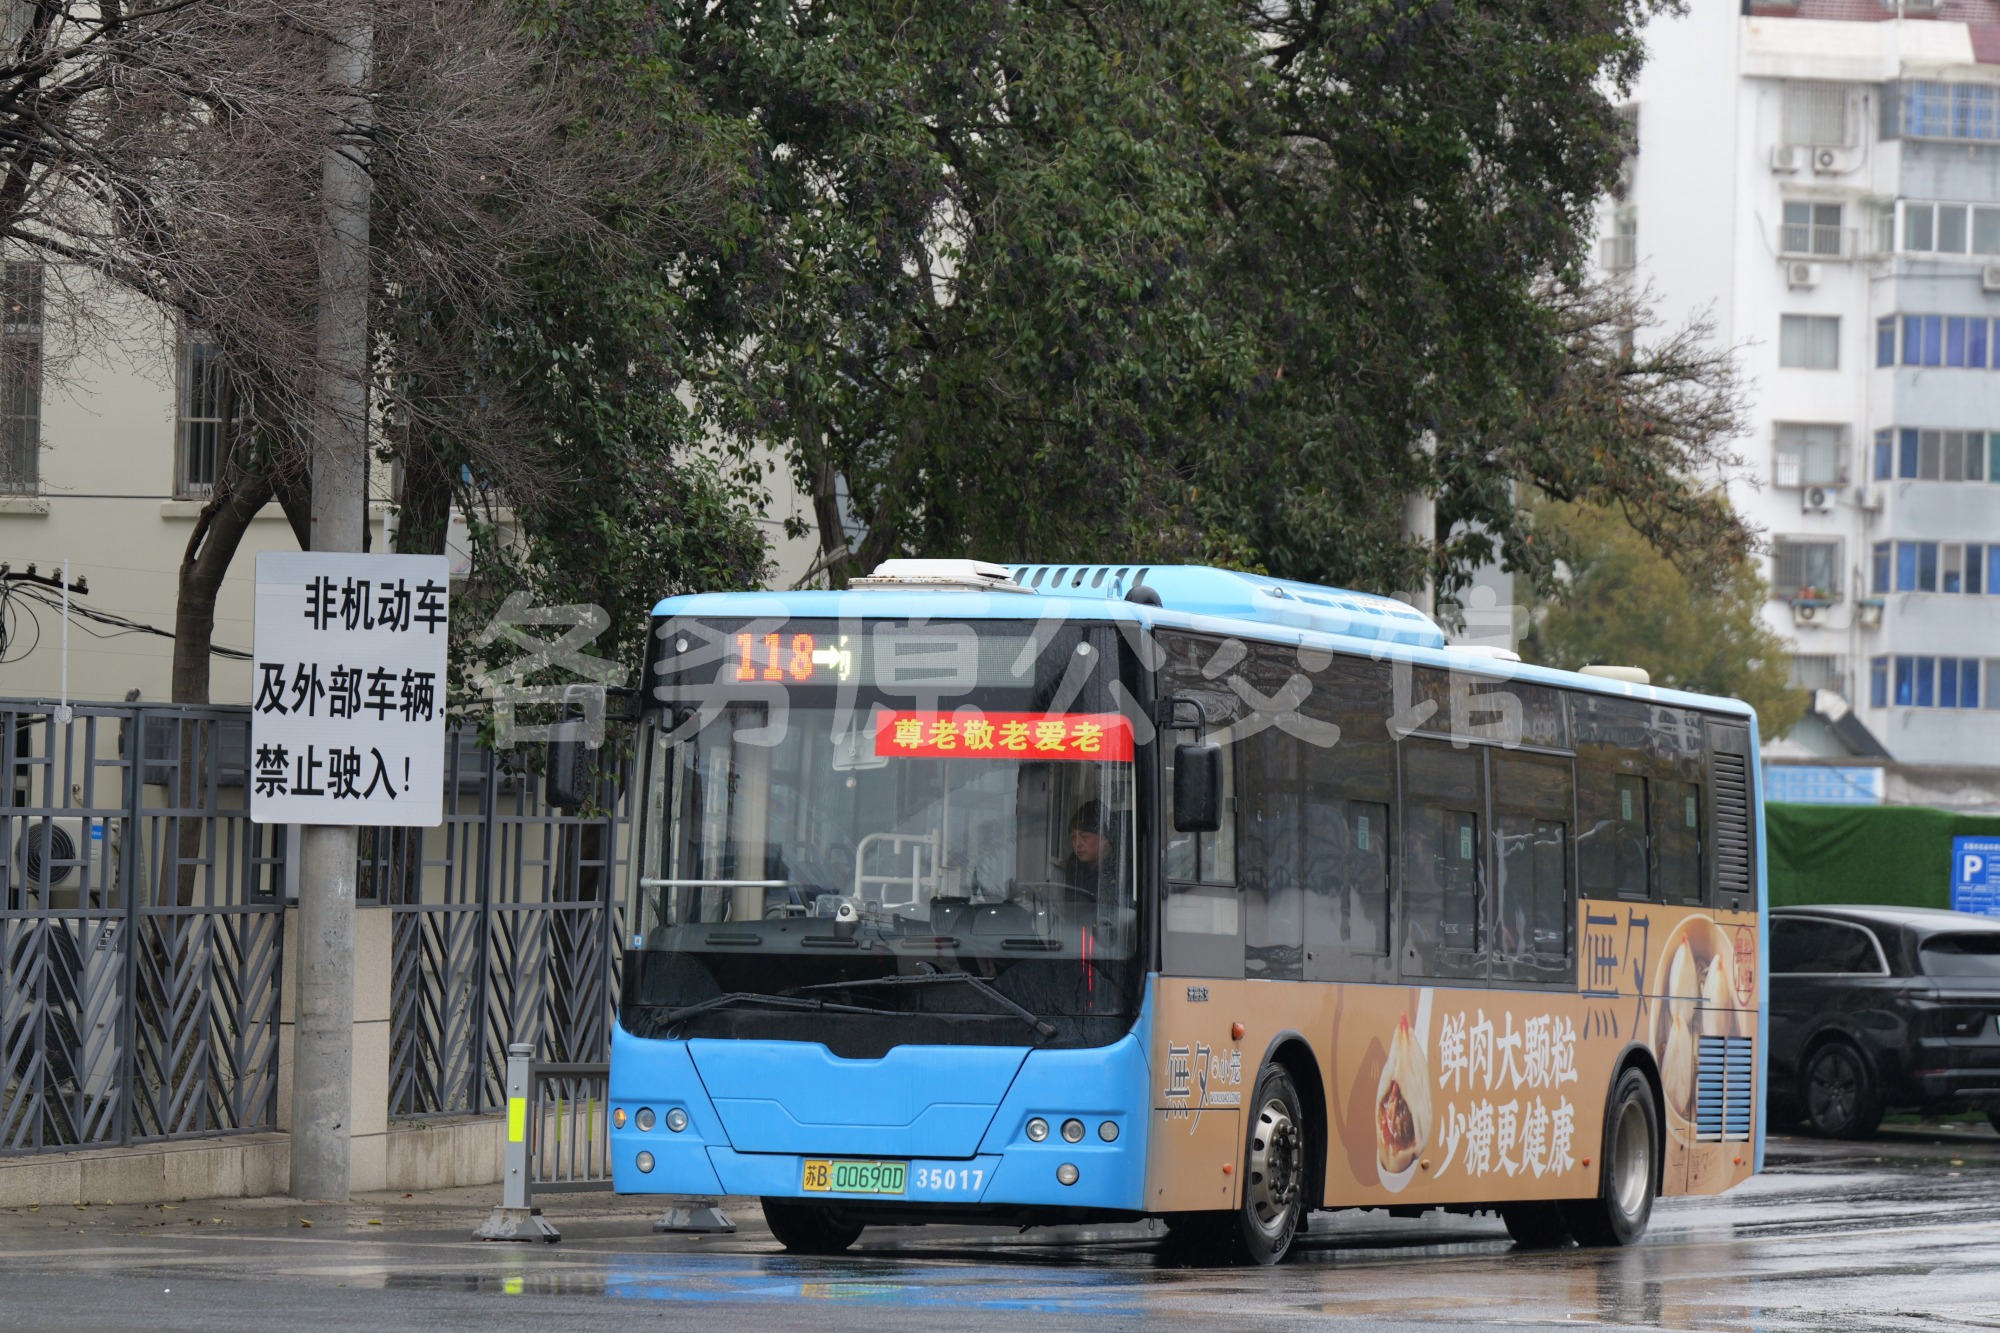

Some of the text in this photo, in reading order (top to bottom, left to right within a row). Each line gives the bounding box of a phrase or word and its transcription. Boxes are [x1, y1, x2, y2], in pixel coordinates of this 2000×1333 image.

[304, 576, 447, 634] 非机动车
[736, 633, 814, 680] 118
[254, 662, 445, 722] 及外部车辆,
[893, 718, 1104, 752] 尊老敬老爱老
[255, 743, 411, 800] 禁止驶入!
[1963, 854, 1983, 882] P
[1438, 1008, 1579, 1092] 鲜肉大颗粒
[1433, 1094, 1575, 1179] 少糖更健康
[916, 1168, 983, 1191] 35017
